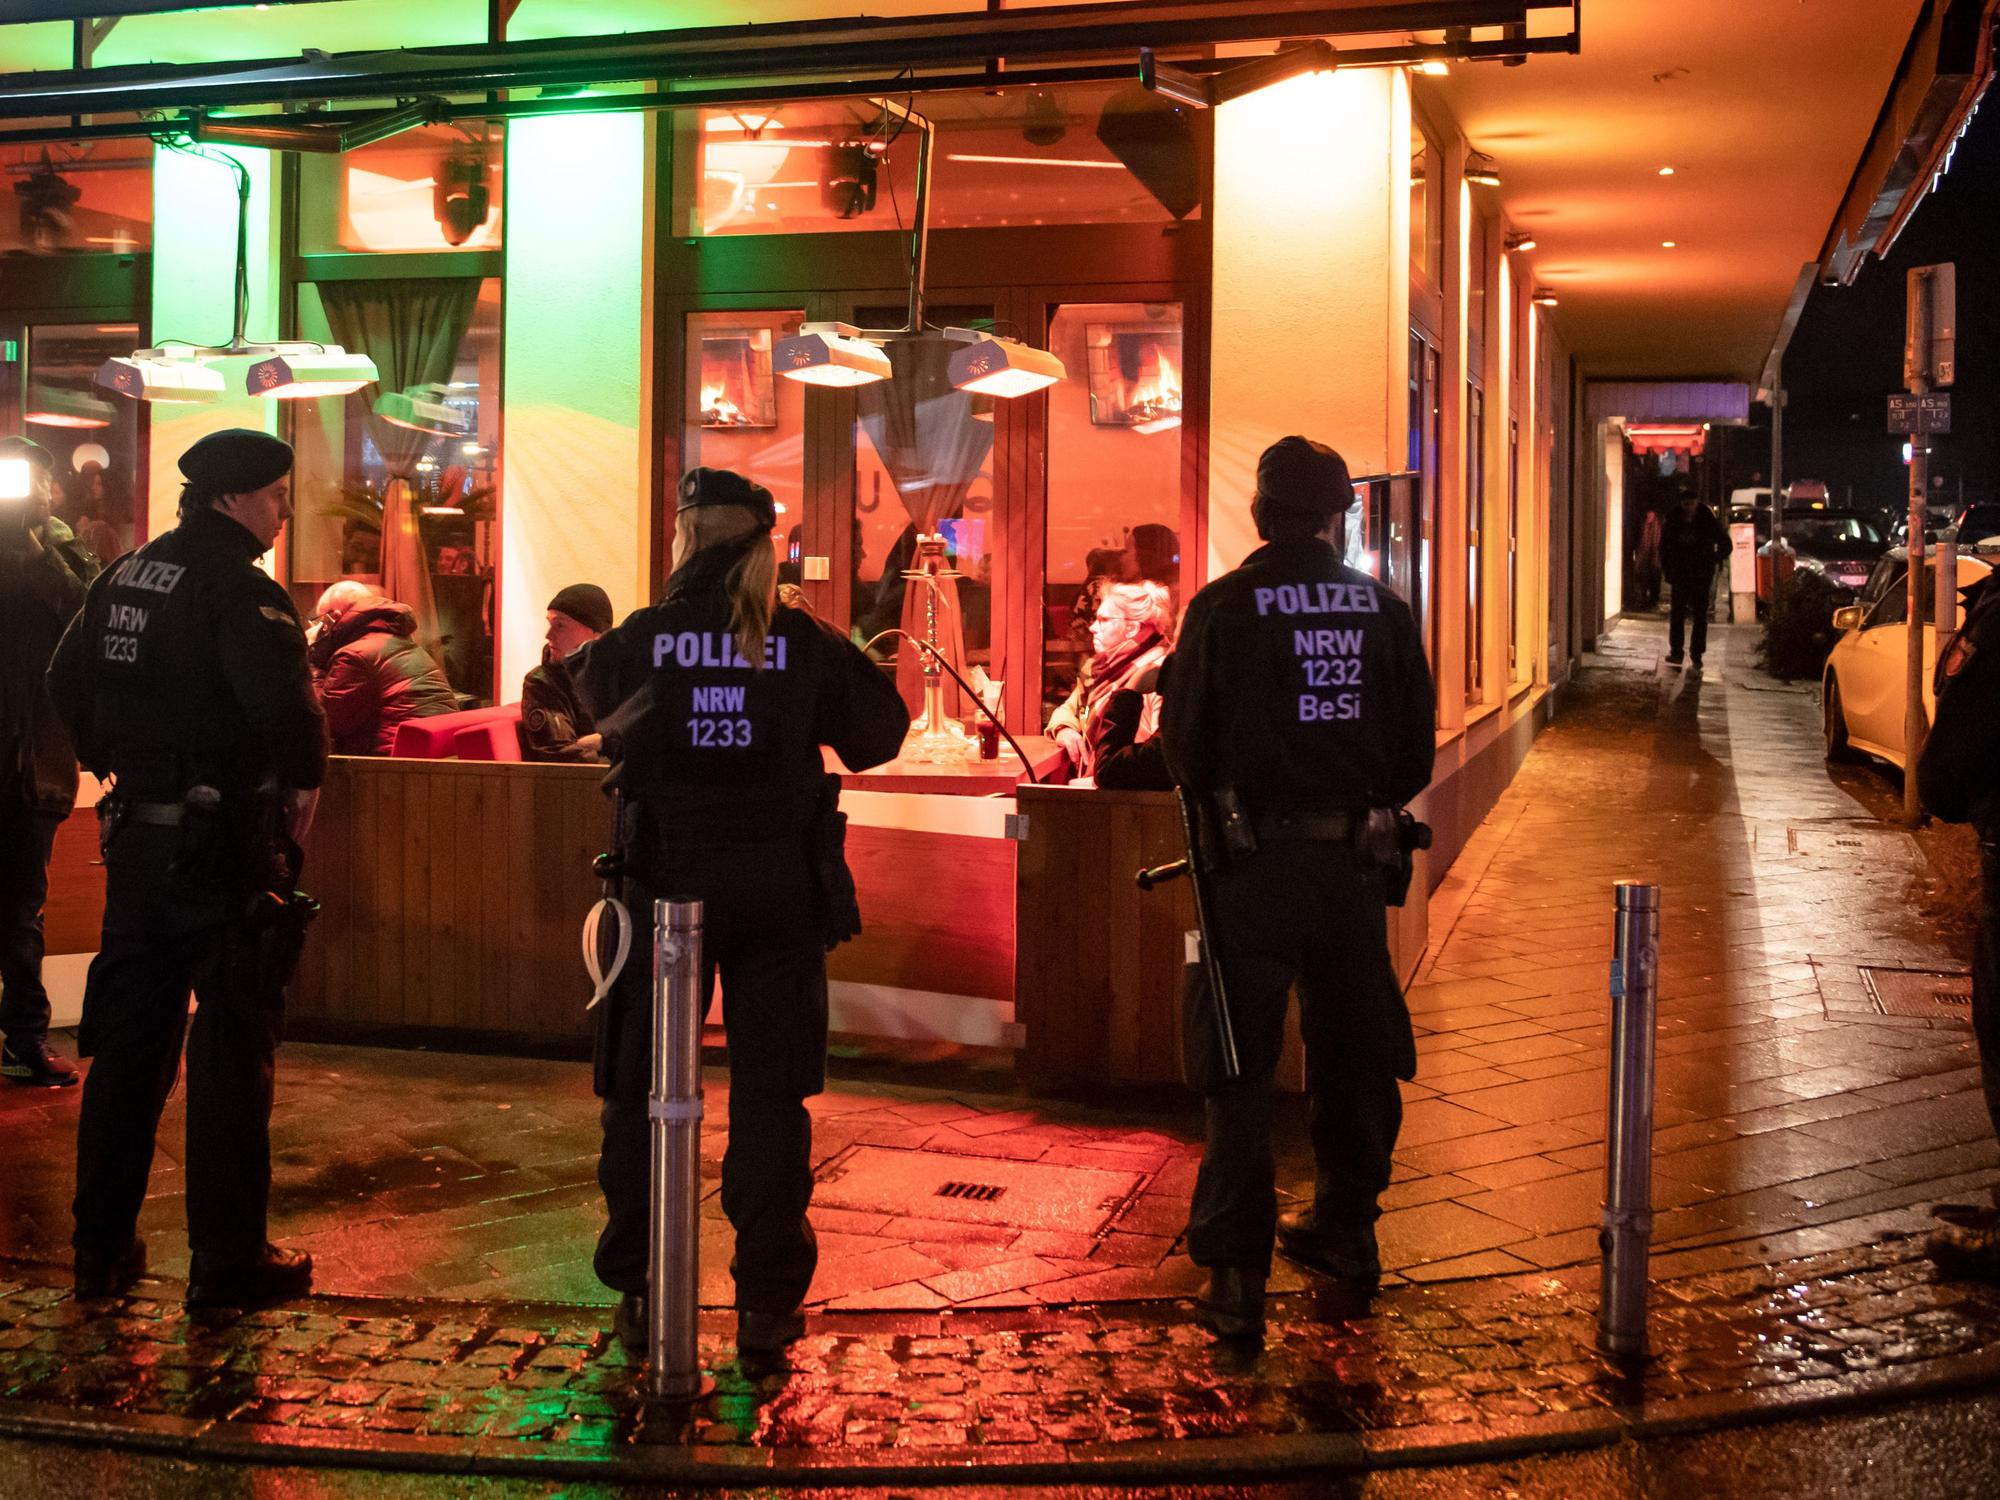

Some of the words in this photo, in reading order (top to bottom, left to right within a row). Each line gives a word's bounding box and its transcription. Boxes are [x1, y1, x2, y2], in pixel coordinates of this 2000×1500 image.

[1254, 583, 1379, 616] POLIZEI
[108, 603, 149, 633] NRW
[104, 635, 138, 662] 1233
[1294, 629, 1364, 656] NRW
[1302, 658, 1362, 686] 1232
[692, 686, 745, 713] NRW
[1298, 693, 1360, 721] BeSi
[687, 718, 752, 747] 1233
